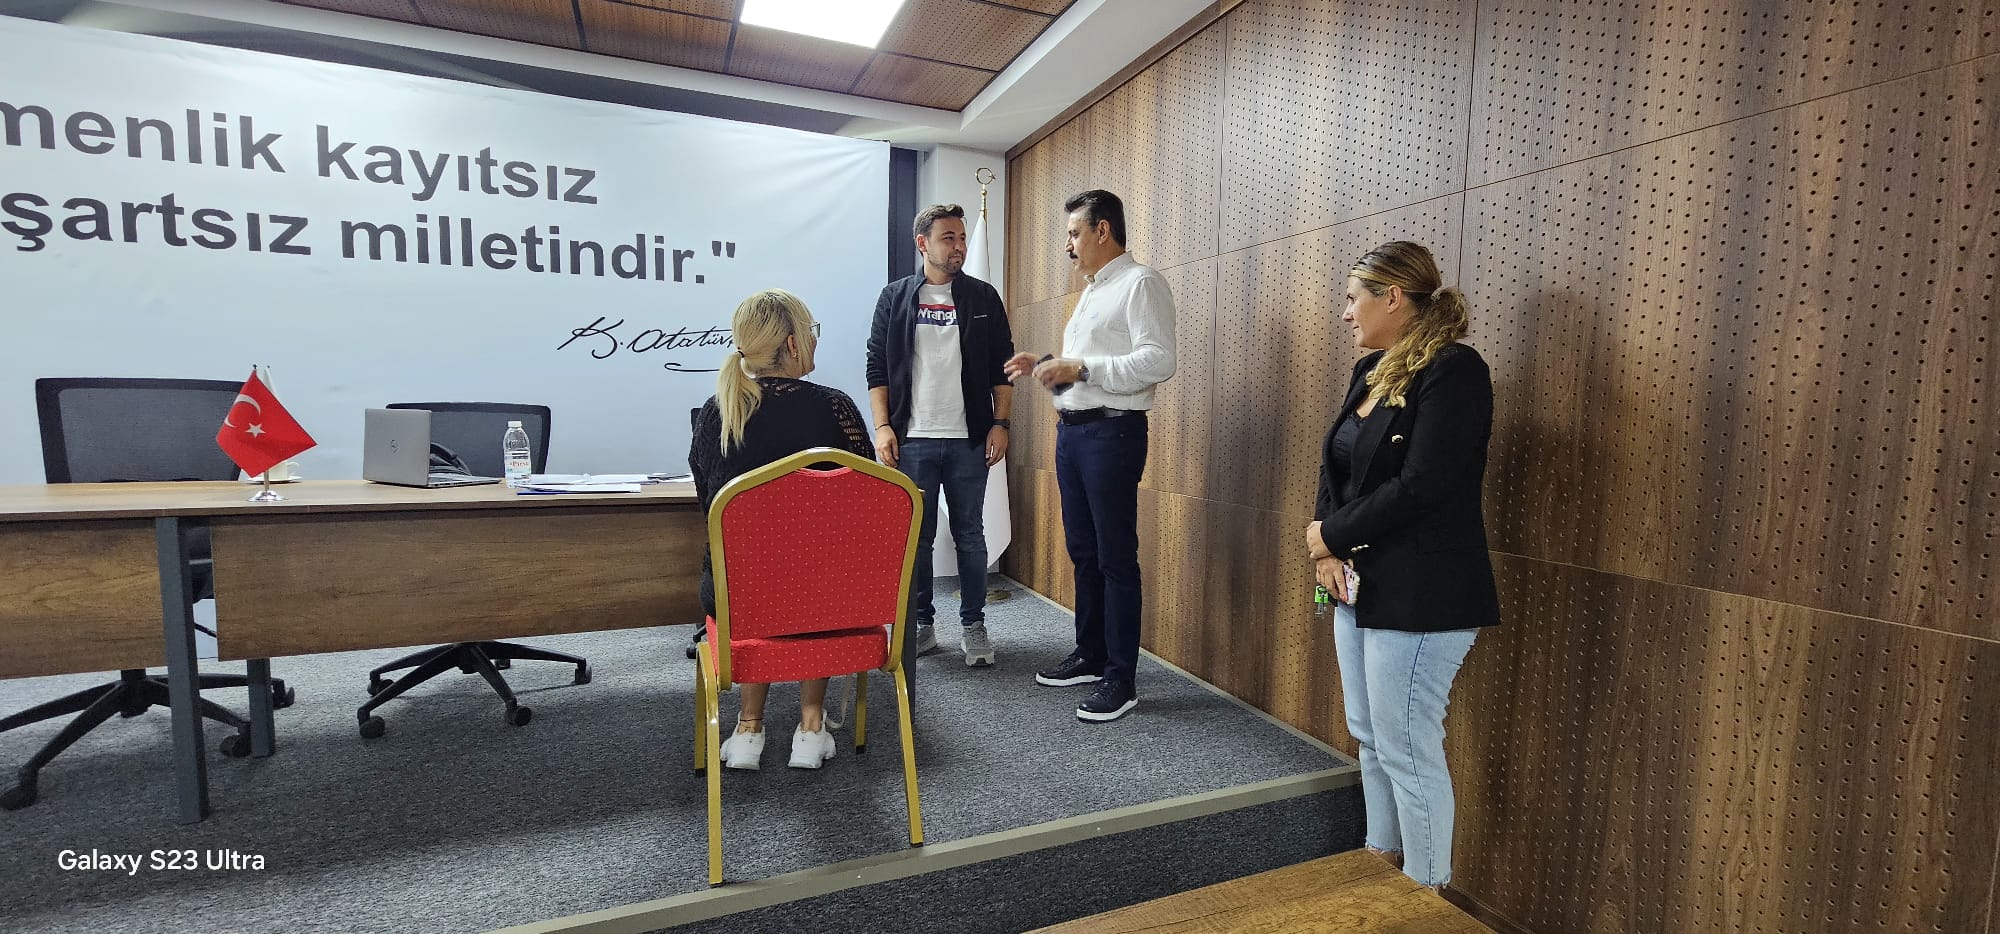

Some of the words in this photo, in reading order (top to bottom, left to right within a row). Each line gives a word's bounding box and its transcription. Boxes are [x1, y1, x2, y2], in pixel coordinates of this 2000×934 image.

[317, 124, 598, 205] kayıtsız
[0, 192, 311, 256] şartsız
[341, 213, 737, 285] milletindir."
